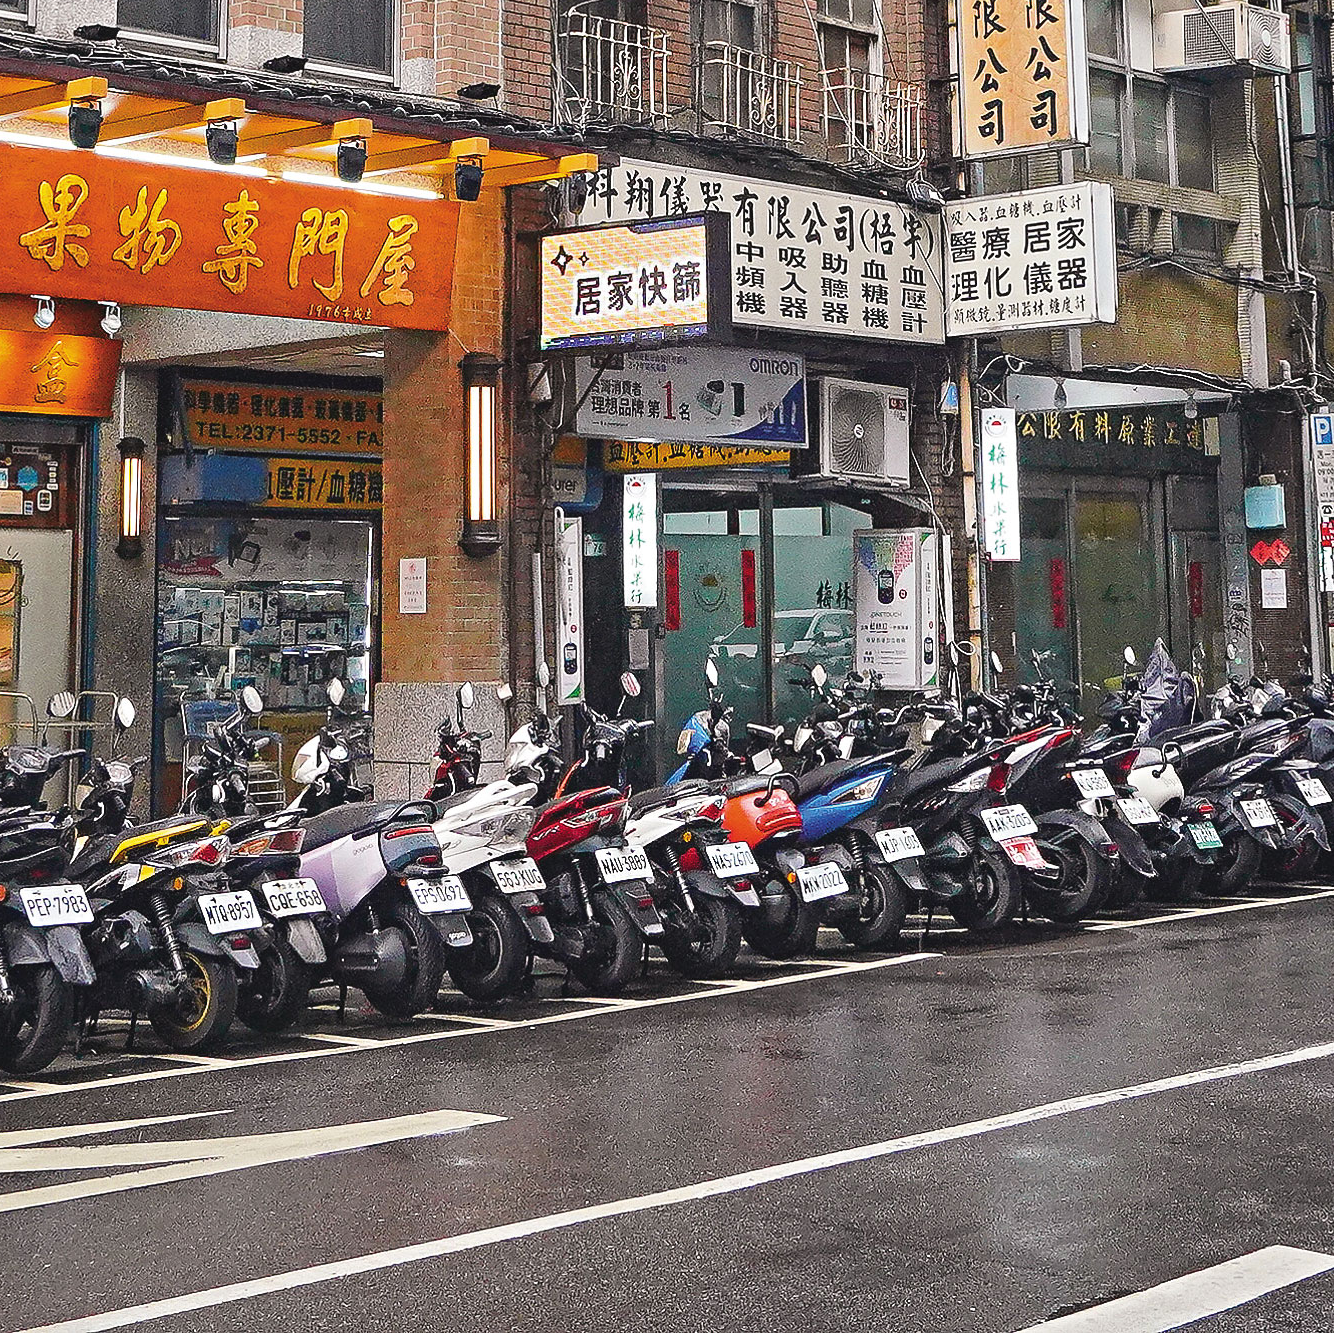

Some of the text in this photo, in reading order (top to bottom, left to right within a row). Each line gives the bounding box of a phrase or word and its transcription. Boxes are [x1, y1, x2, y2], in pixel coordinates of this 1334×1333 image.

[575, 262, 701, 316] 居家快篩
[735, 242, 765, 315] 中頻機
[778, 246, 809, 320] 吸入器
[821, 253, 849, 325] 助聽器
[861, 259, 889, 330] 血糖機
[900, 265, 928, 334] 血壓計
[1315, 418, 1330, 444] P
[267, 466, 383, 505] 壓計/血糖機
